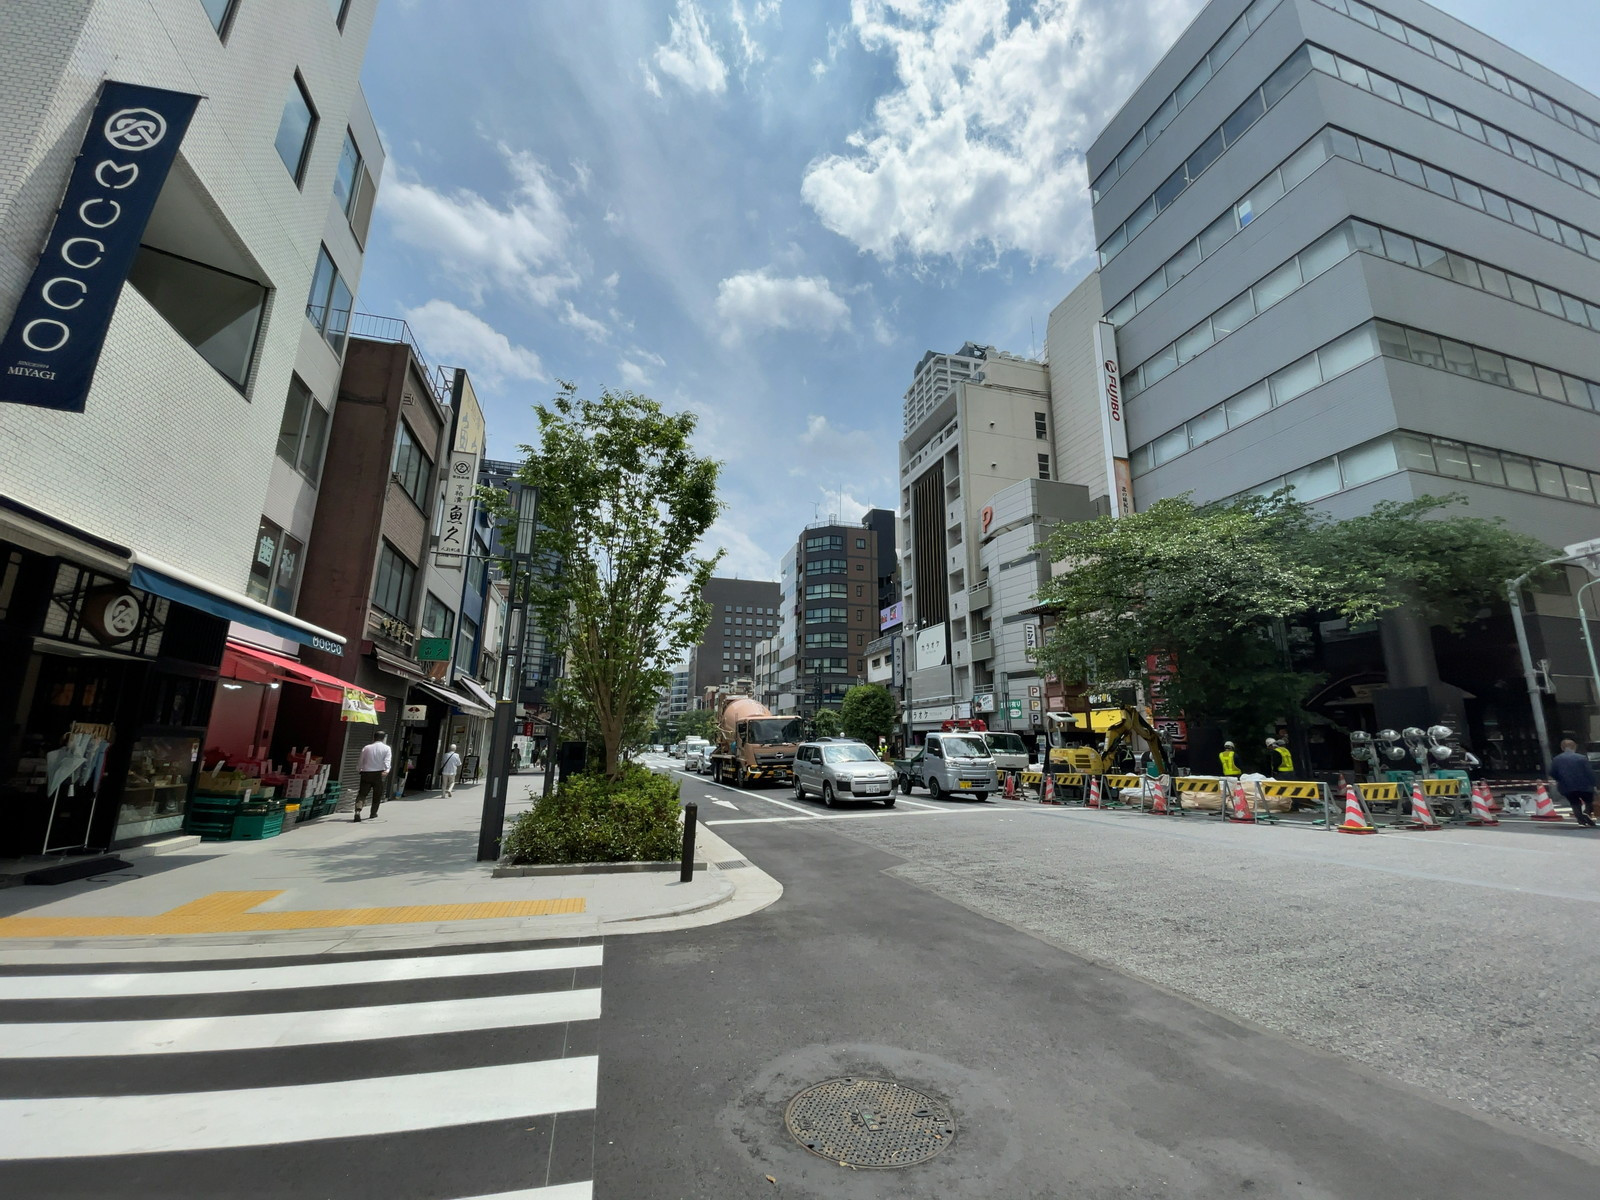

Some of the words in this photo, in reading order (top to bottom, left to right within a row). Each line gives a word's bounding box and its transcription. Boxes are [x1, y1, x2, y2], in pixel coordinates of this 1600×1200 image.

[7, 366, 56, 380] MIYAGI
[1107, 374, 1120, 421] FUJIBO
[443, 504, 462, 544] 魚久
[921, 640, 940, 651] カラオケ
[1031, 687, 1039, 696] P
[1032, 701, 1040, 710] P
[1032, 714, 1039, 723] P
